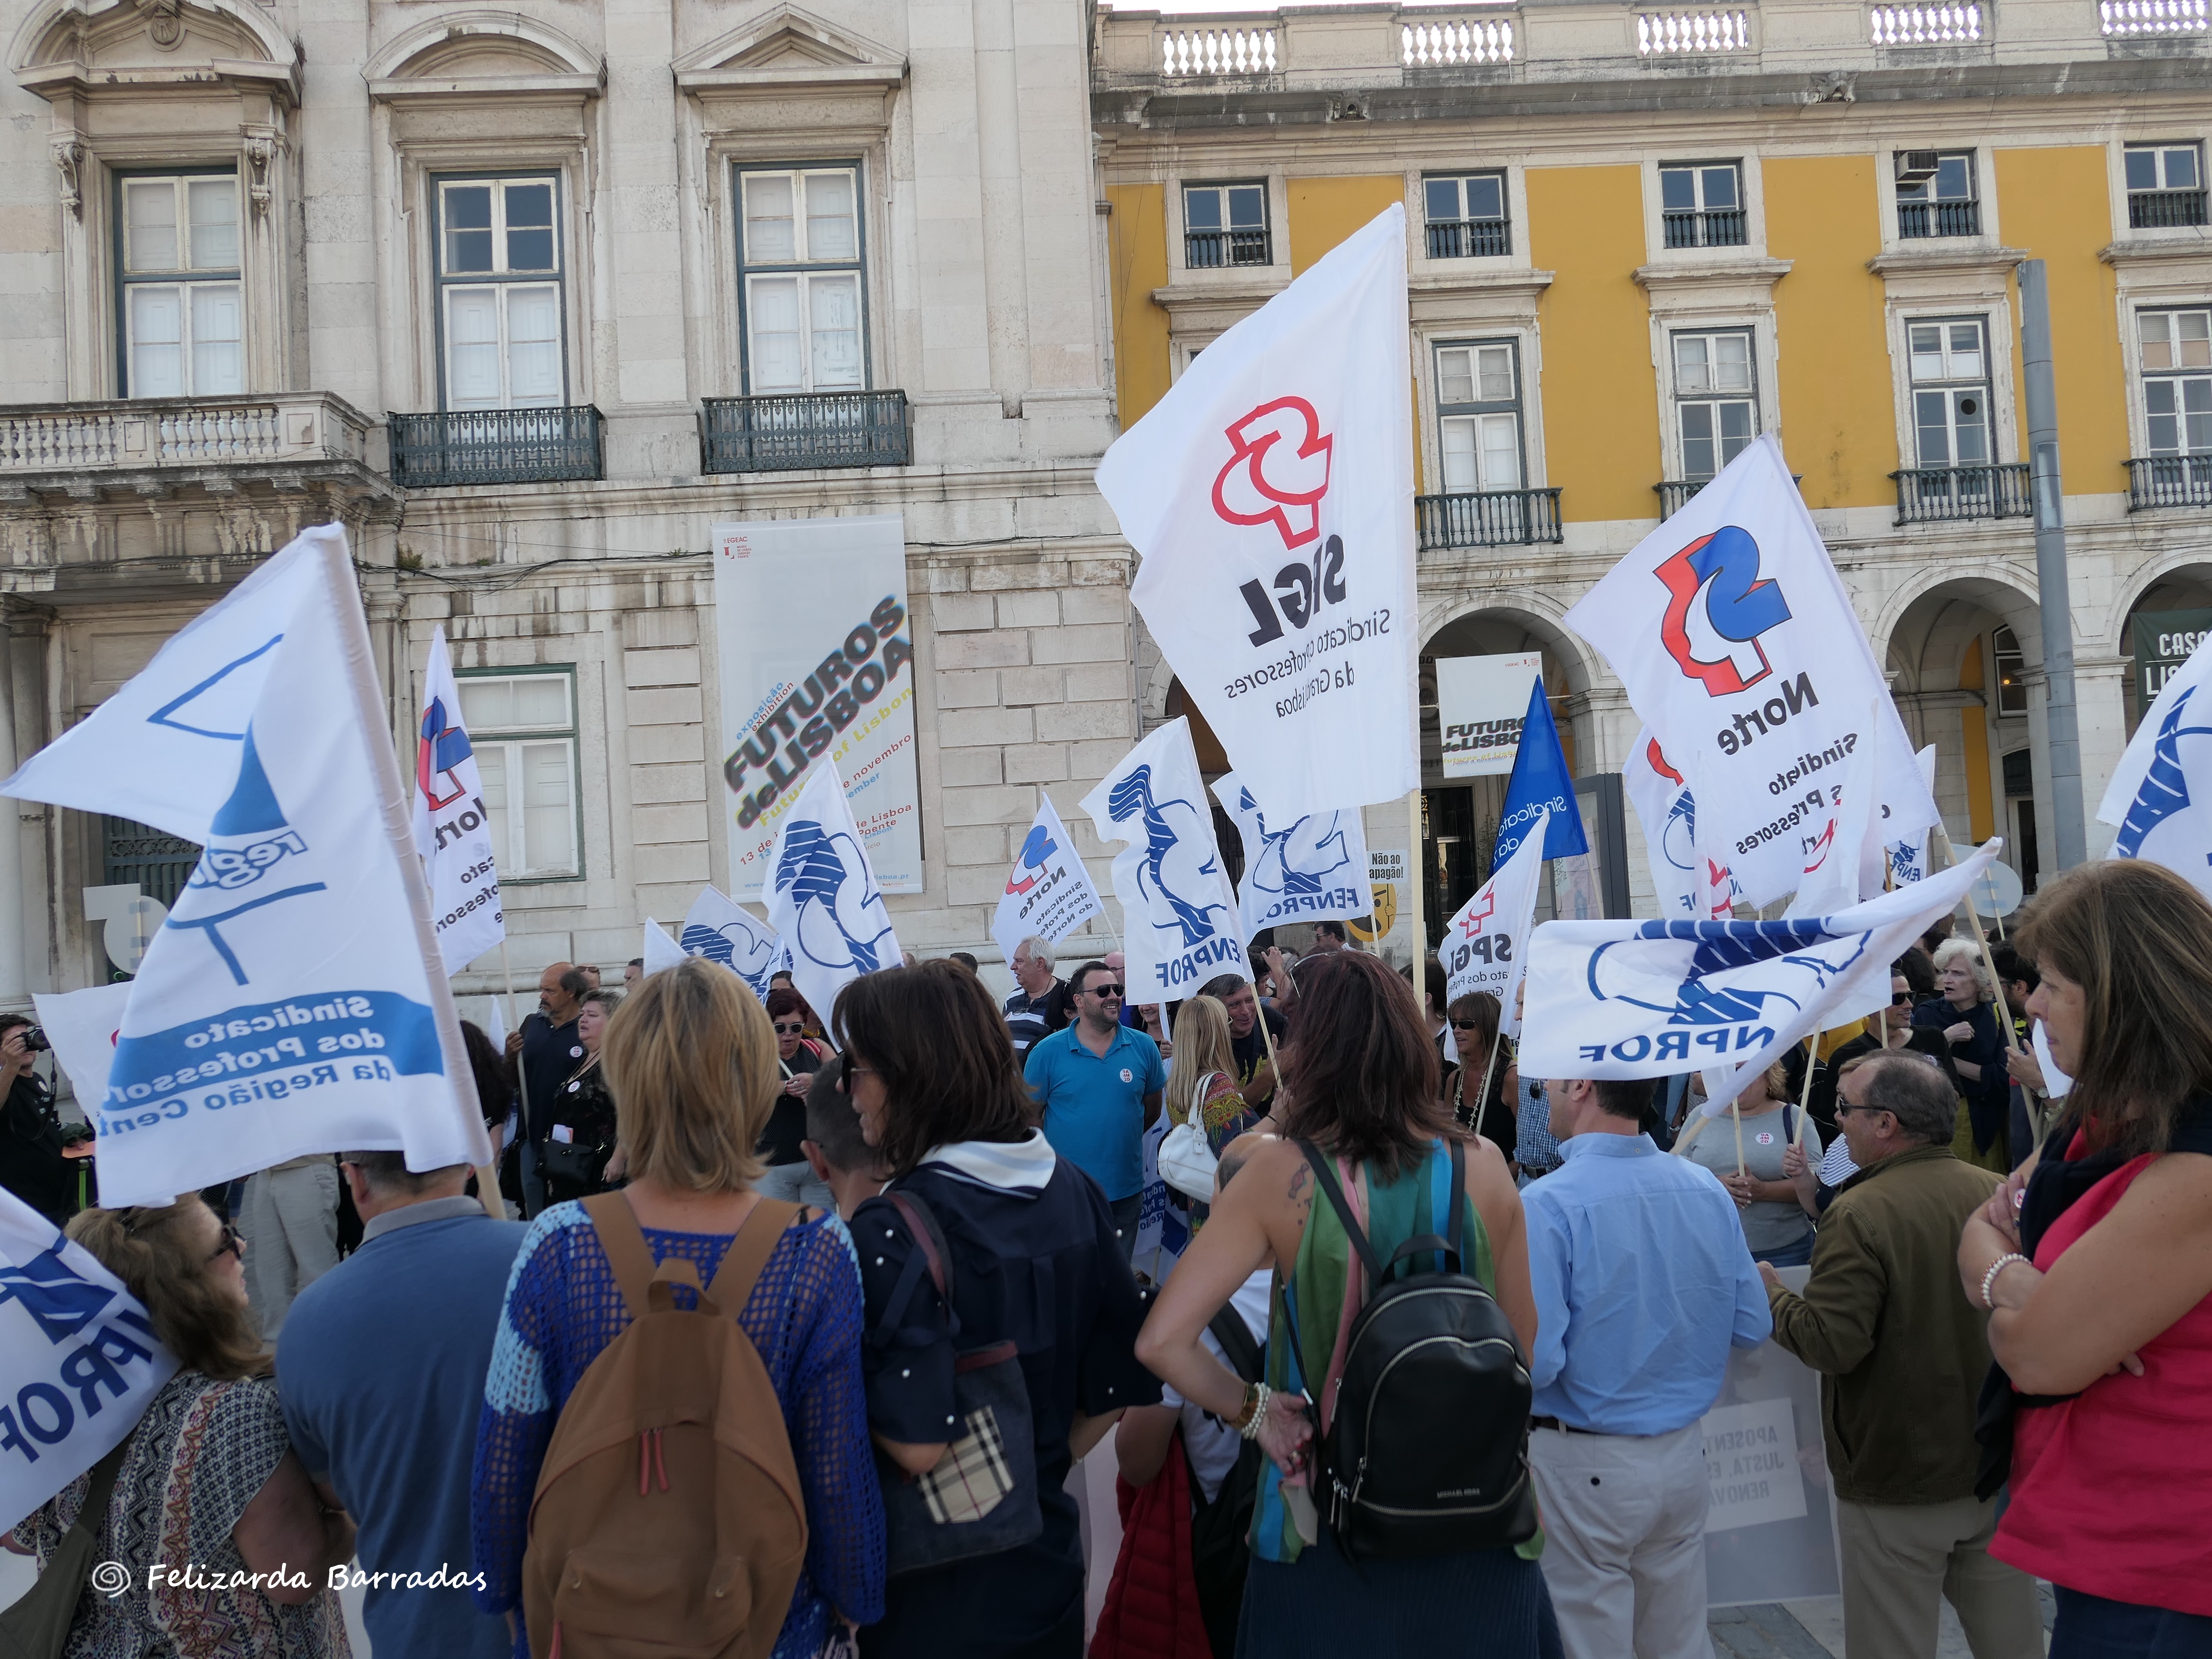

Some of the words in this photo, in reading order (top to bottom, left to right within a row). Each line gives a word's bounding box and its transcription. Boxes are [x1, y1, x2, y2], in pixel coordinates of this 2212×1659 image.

[723, 593, 905, 794] FUTUROS
[736, 681, 783, 740] exposição
[752, 682, 794, 732] exhibition
[833, 739, 850, 762] of
[853, 687, 913, 742] Lisbon
[853, 734, 911, 781] novembro
[845, 773, 880, 799] ember
[872, 804, 911, 824] Lisboa
[859, 819, 896, 835] Poente
[865, 826, 891, 839] Lisbon
[740, 851, 754, 865] 13
[758, 840, 772, 853] de
[759, 848, 771, 860] 13
[1372, 853, 1388, 865] Não
[1391, 855, 1400, 864] ao
[1369, 866, 1403, 880] apagão!
